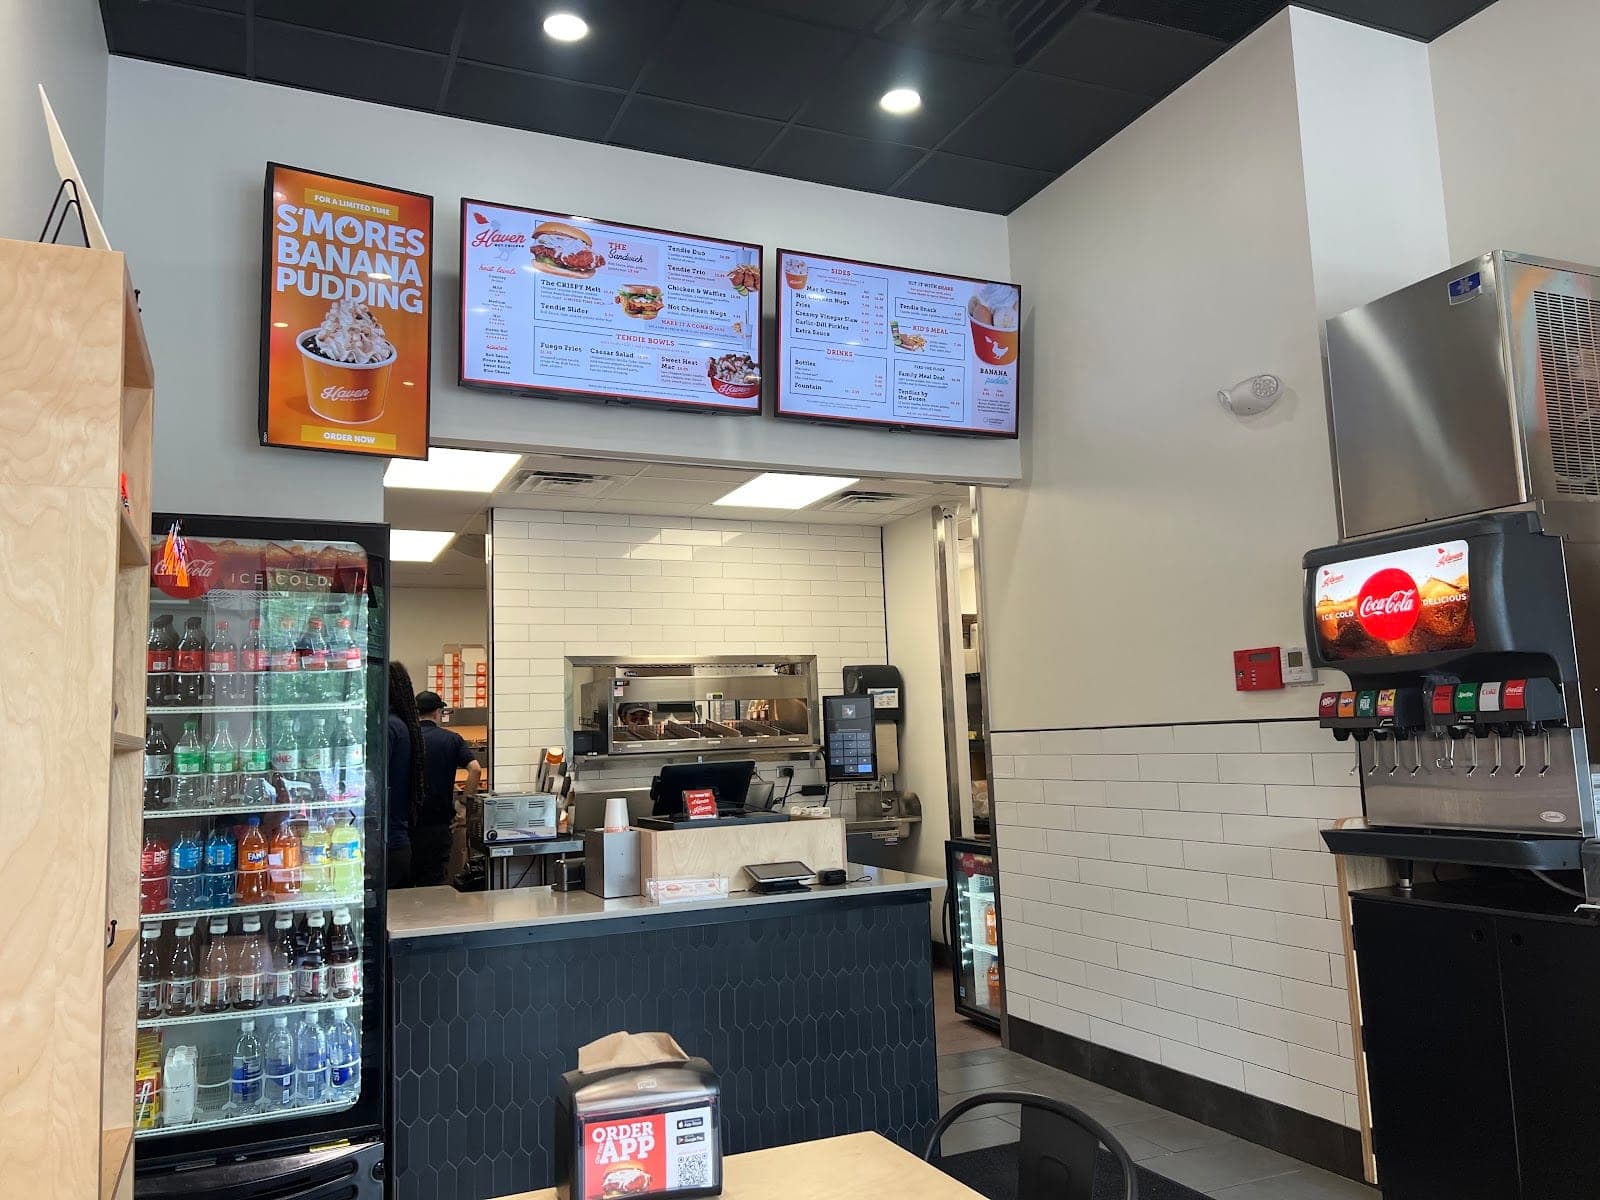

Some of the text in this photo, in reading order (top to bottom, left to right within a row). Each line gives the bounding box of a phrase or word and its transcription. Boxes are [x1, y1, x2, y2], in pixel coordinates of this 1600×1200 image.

[314, 194, 332, 204] FOR
[338, 199, 371, 212] LIMITED
[371, 204, 391, 216] TIME
[277, 204, 425, 256] S'MORES
[472, 229, 527, 248] Haven
[608, 242, 627, 250] THE
[668, 246, 706, 256] Tendie Duo
[277, 235, 424, 287] BANANA
[609, 249, 644, 263] Sandwich
[668, 265, 691, 273] Tendie
[831, 269, 851, 277] SIDES
[276, 266, 424, 314] PUDDING
[540, 279, 555, 287] The
[556, 282, 584, 291] CRISPY
[668, 285, 695, 293] Chicken
[702, 289, 727, 297] Waffles
[825, 288, 847, 296] Cheese
[540, 303, 566, 311] Tendie
[681, 305, 709, 315] Chicken
[710, 309, 727, 318] Nugs
[900, 303, 919, 311] Tendie
[795, 310, 819, 319] Creamy
[820, 314, 844, 322] Vinegar
[691, 323, 714, 331] COMBO
[828, 323, 849, 331] Pickles
[912, 325, 949, 335] KID'S MEAL
[812, 329, 830, 337] Sauce
[616, 334, 676, 347] TENDIE BOWLS
[540, 342, 583, 353] Fuego Fries
[590, 348, 614, 356] Caesar
[615, 350, 634, 358] Salad
[826, 349, 853, 357] DRINKS
[661, 356, 698, 366] Sweet Heat
[794, 359, 817, 367] Bottles
[979, 367, 1008, 377] BANANA
[794, 383, 822, 391] Fountain
[898, 388, 920, 396] Tendies
[321, 385, 371, 401] Haven
[323, 432, 376, 445] ORDER NOW
[231, 573, 329, 587] ICE COLD
[1422, 593, 1468, 606] DELICIOUS
[1321, 610, 1354, 622] ICE COLD
[592, 1121, 655, 1143] ORDER
[600, 1135, 656, 1165] APP
